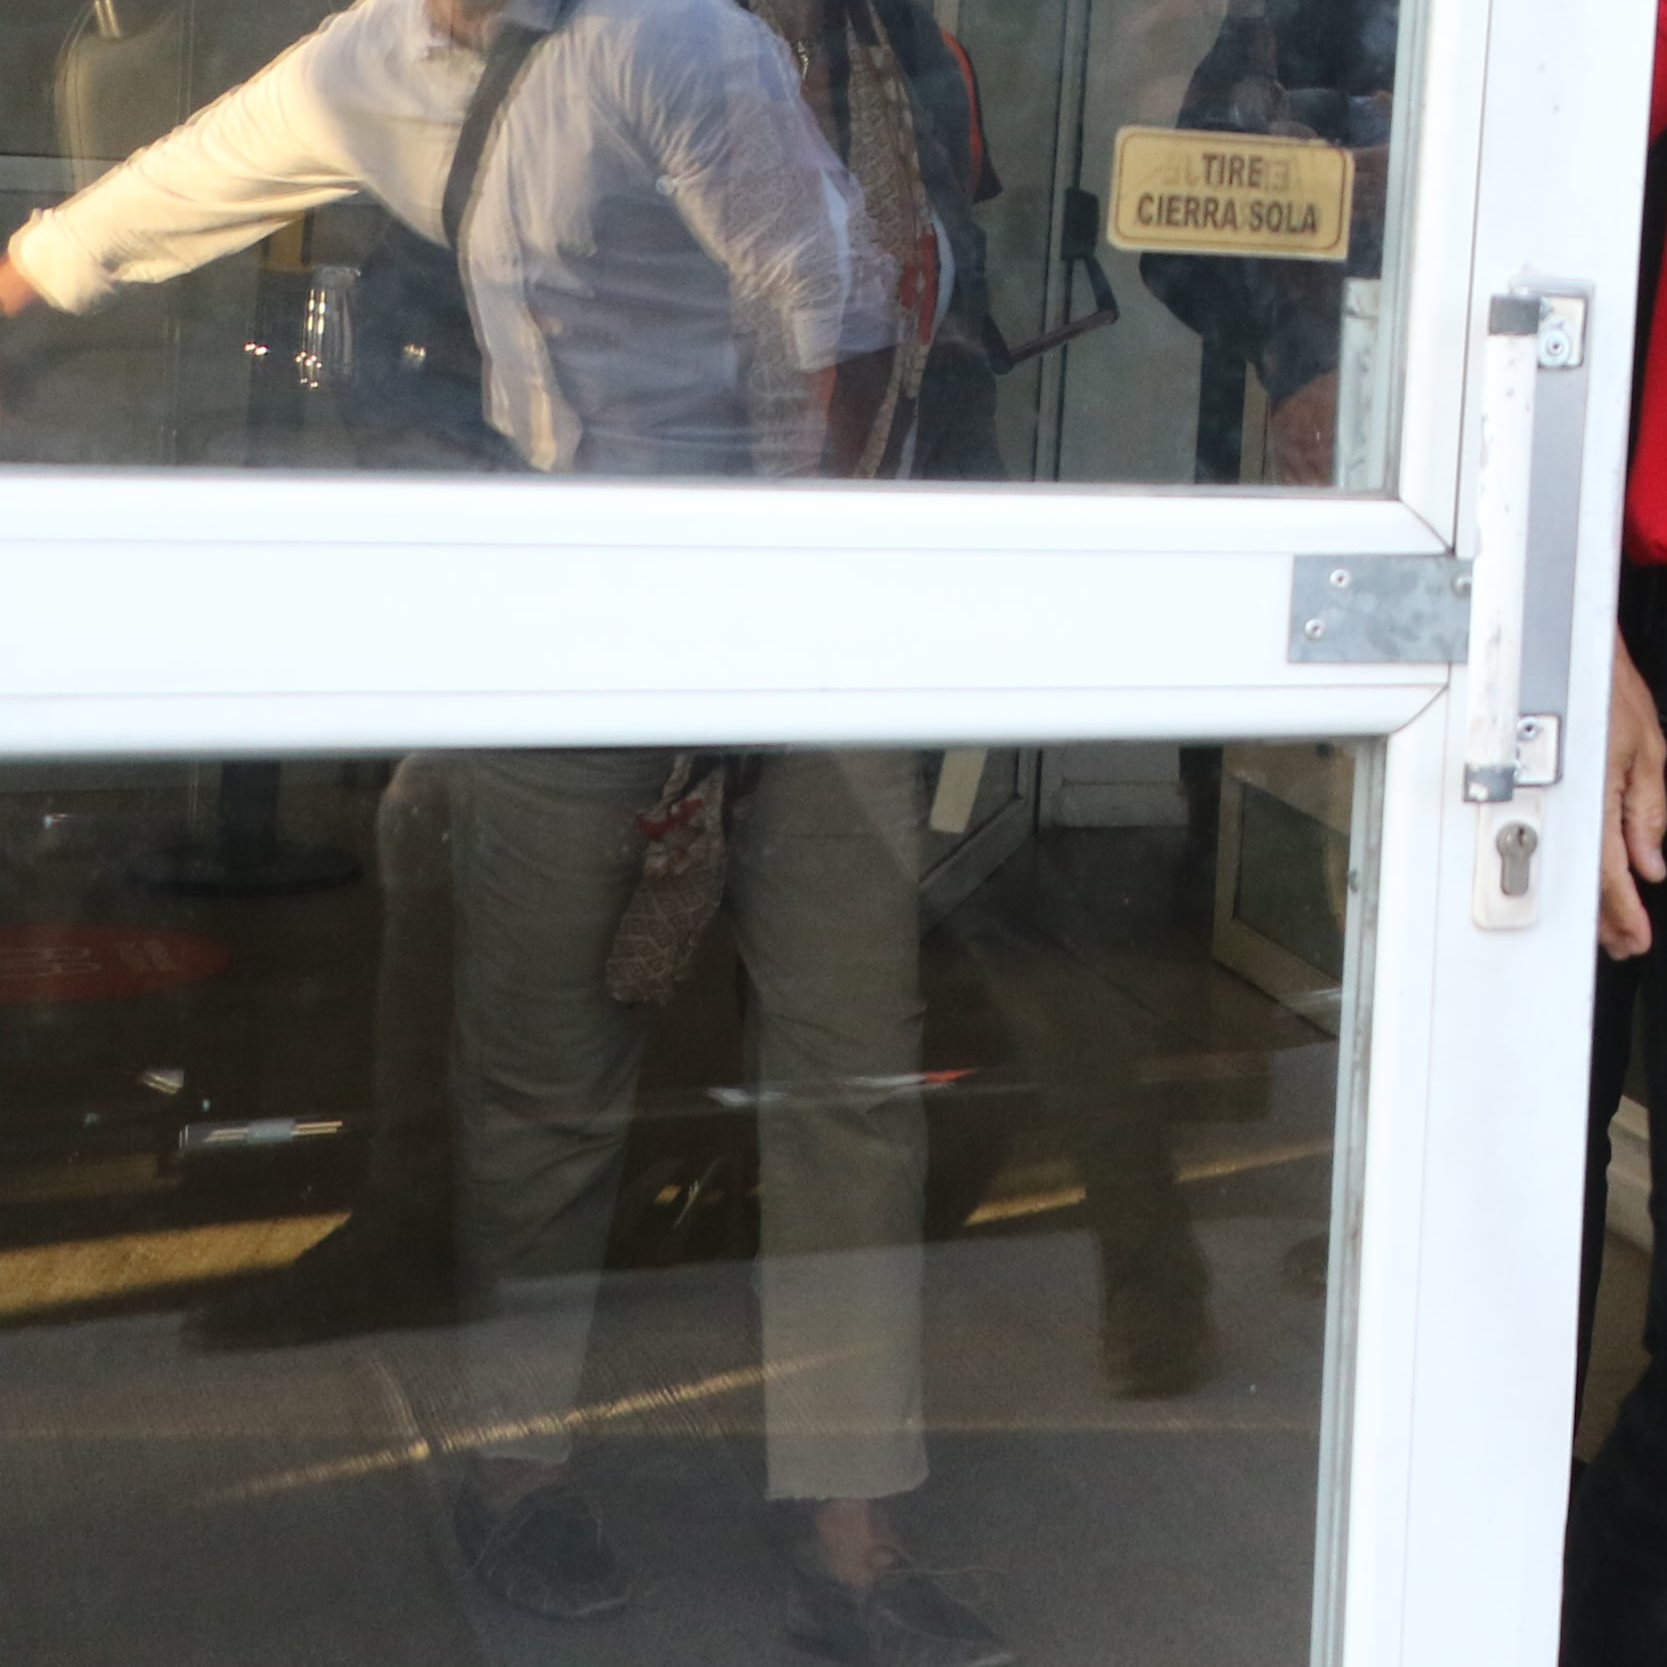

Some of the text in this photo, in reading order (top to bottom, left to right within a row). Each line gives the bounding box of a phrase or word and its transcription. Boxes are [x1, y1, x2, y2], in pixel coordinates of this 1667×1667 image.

[1201, 152, 1263, 189] TIRE
[1137, 192, 1317, 234] CIERRA SOLA
